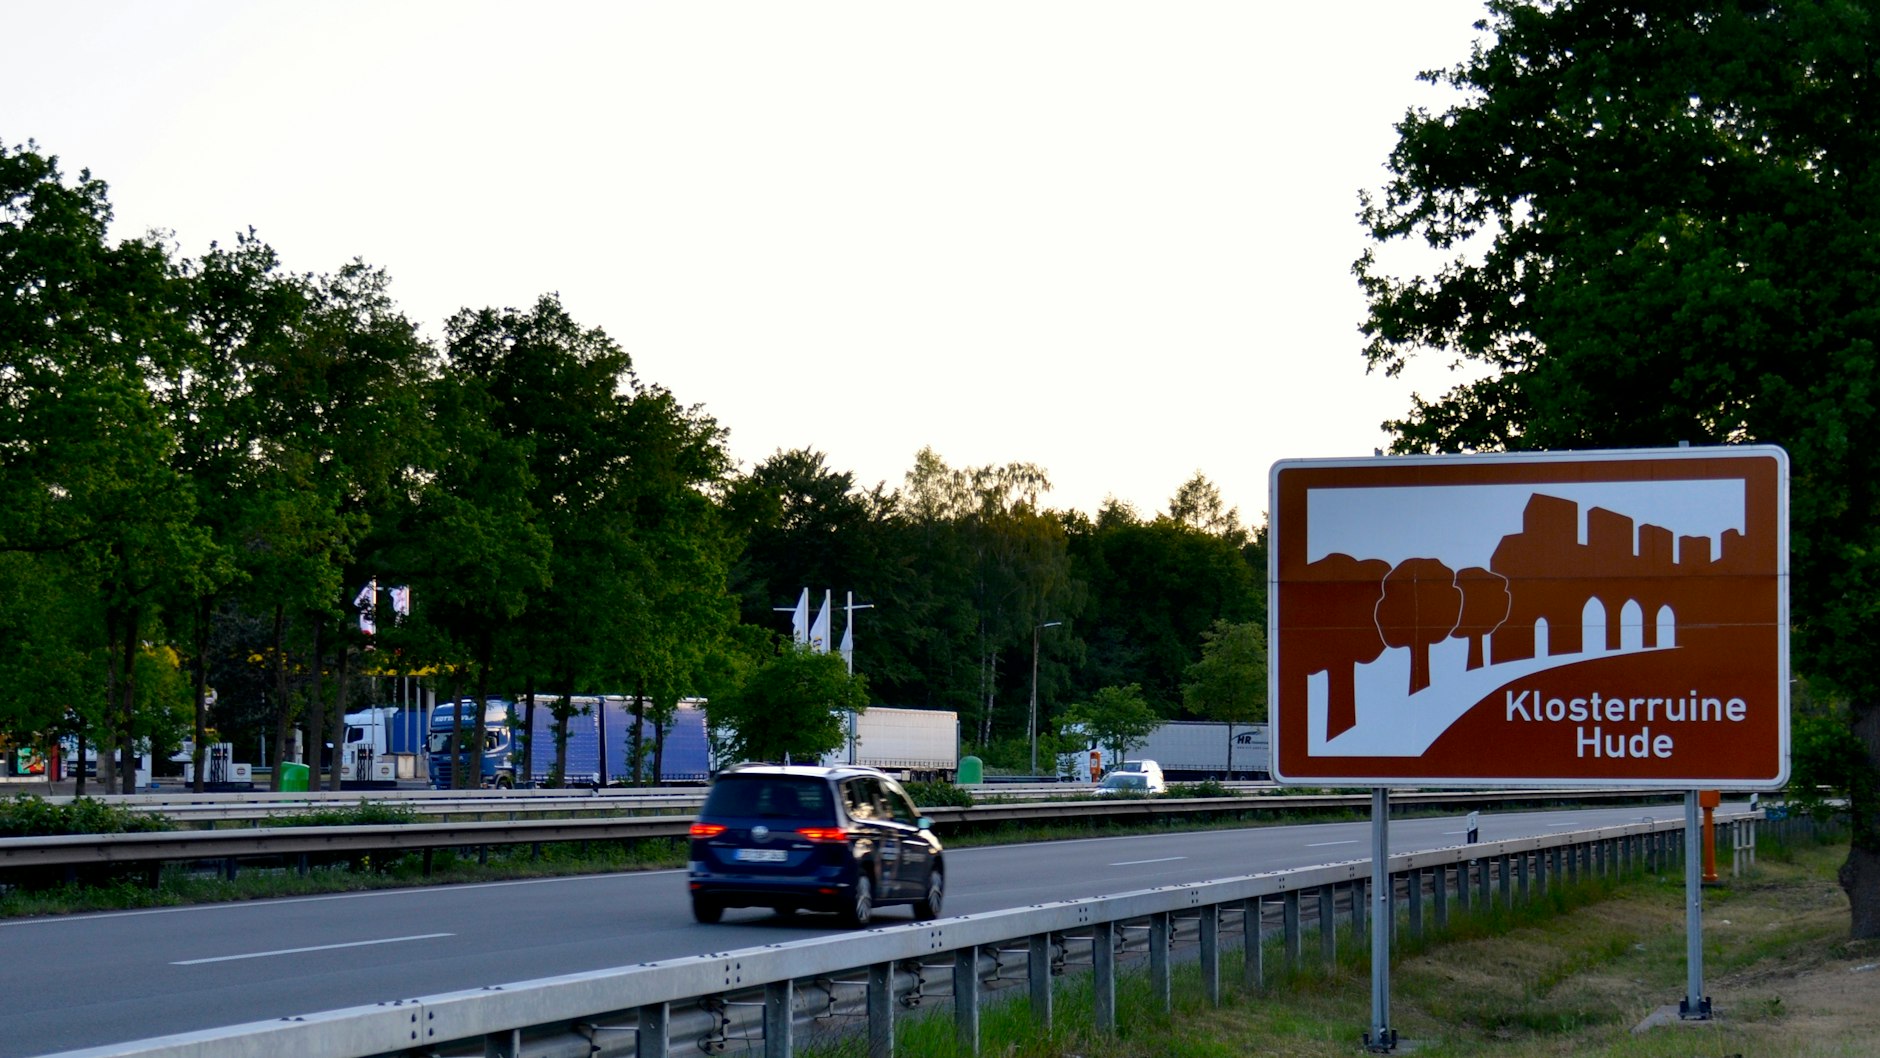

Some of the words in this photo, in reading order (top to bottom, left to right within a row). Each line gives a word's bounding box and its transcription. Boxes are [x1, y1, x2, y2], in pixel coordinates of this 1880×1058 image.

[1506, 690, 1747, 722] Klosterruine
[1237, 735, 1252, 745] HR
[1577, 726, 1674, 758] Hude
